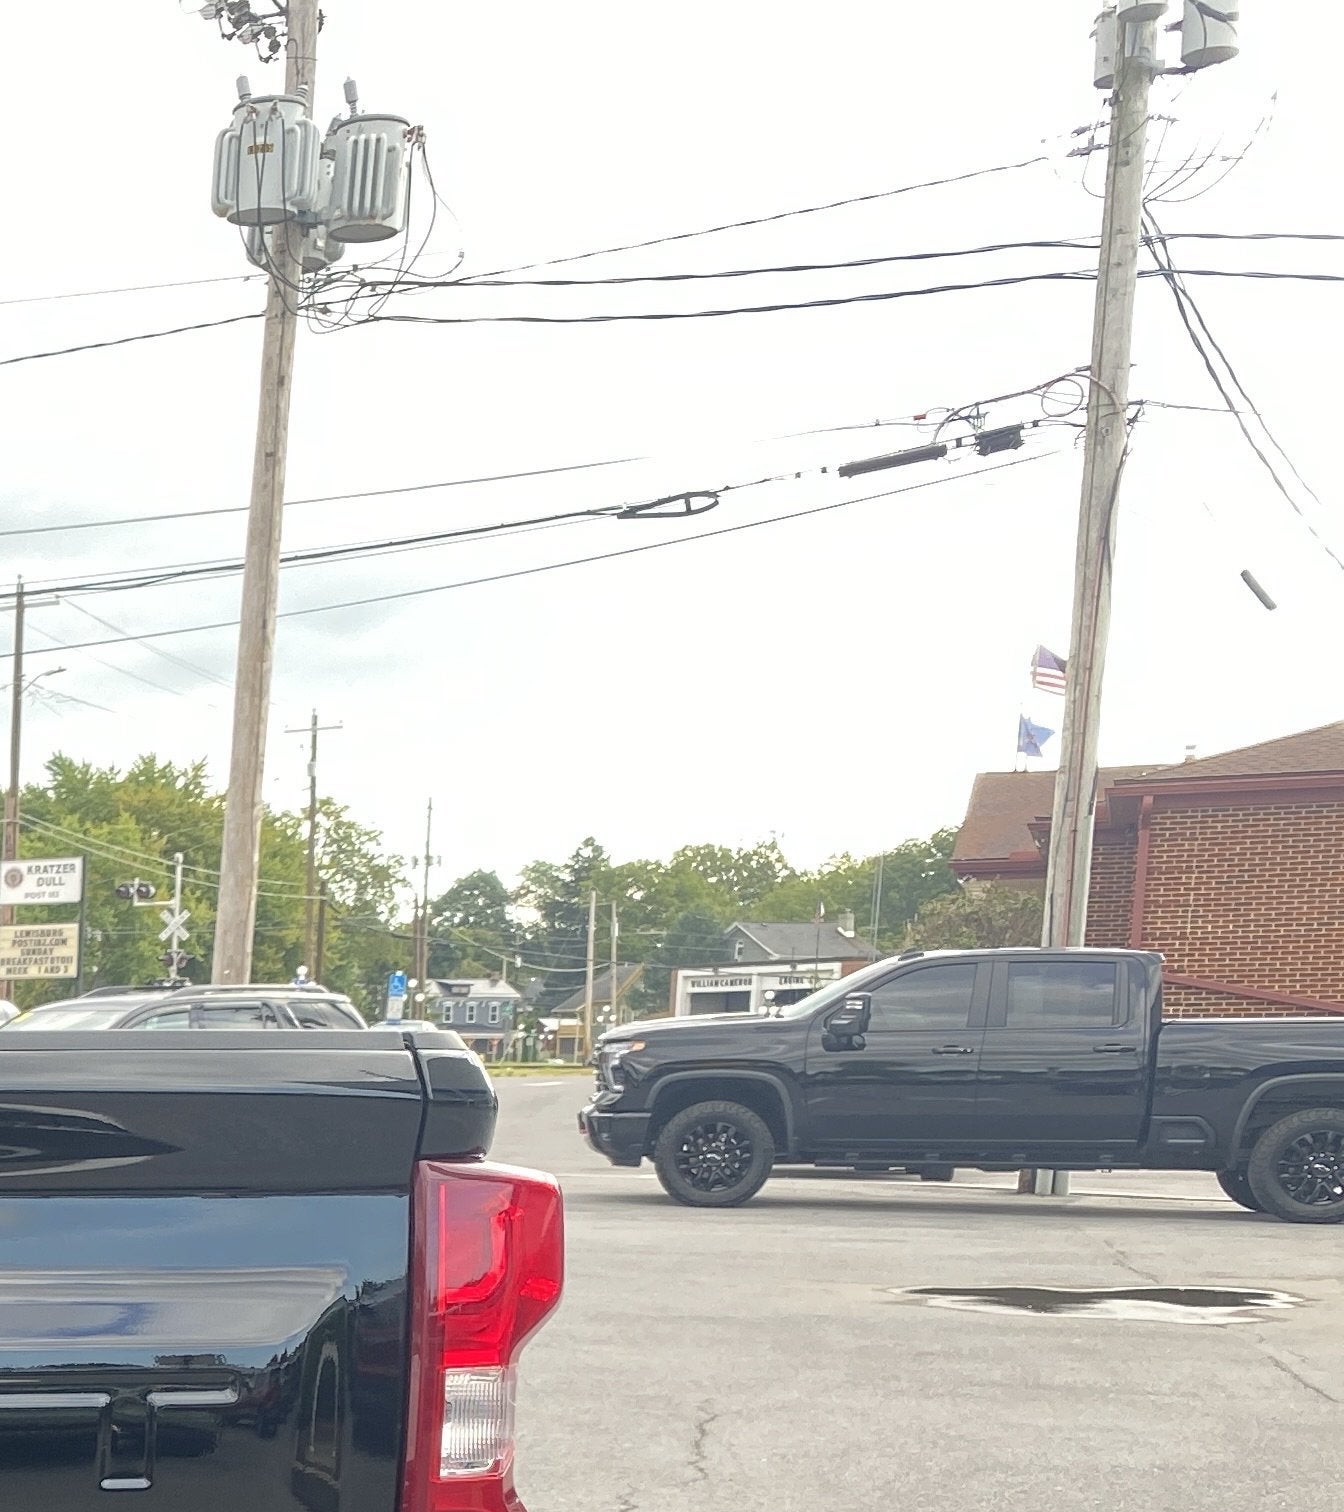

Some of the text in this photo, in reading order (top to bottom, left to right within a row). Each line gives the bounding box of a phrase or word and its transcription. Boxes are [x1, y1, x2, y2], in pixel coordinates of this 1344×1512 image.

[26, 863, 77, 875] KRATZER
[36, 876, 66, 887] DULL
[20, 947, 55, 956] SUNDAY
